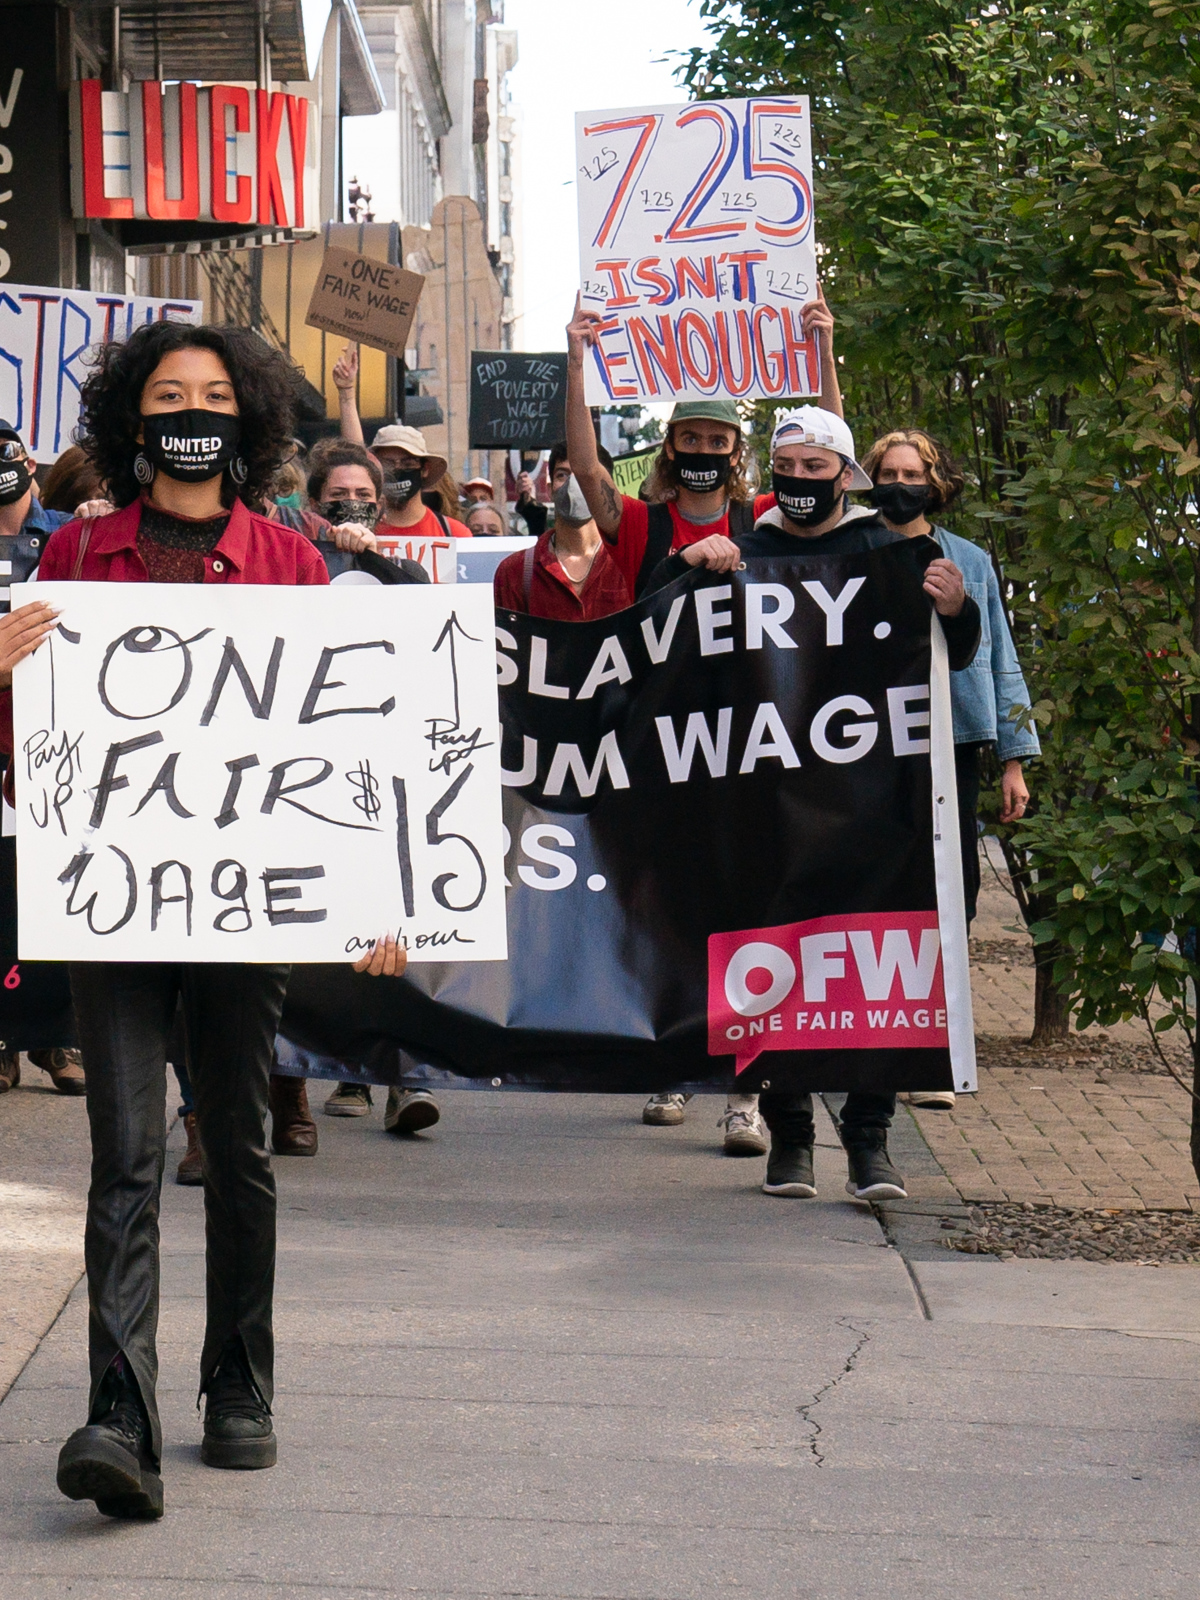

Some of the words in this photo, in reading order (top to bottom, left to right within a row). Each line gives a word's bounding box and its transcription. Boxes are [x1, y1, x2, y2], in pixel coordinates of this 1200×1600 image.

[80, 78, 309, 229] LUCKY
[583, 98, 813, 249] 7.25
[321, 273, 362, 302] FAIR
[367, 290, 410, 317] WAGE
[350, 258, 394, 290] ONE
[595, 249, 768, 310] ISN'T
[476, 359, 507, 386] END
[524, 360, 560, 381] THE
[590, 303, 821, 400] ENOUGH
[490, 380, 559, 399] POVERTY
[506, 401, 550, 418] WAGE
[161, 435, 222, 453] UNITED
[487, 418, 547, 439] TODAY!
[202, 452, 218, 461] JUST
[680, 468, 718, 481] UNITED
[779, 491, 816, 508] UNITED
[496, 576, 892, 701] SLAVERY.
[98, 624, 397, 727] ONE
[654, 684, 931, 784] WAGE
[85, 730, 384, 832] FAIR
[503, 823, 607, 892] S.
[724, 928, 941, 1017] OFW
[725, 1013, 783, 1041] ONE
[796, 1010, 855, 1031] FAIR
[866, 1008, 947, 1029] WAGE
